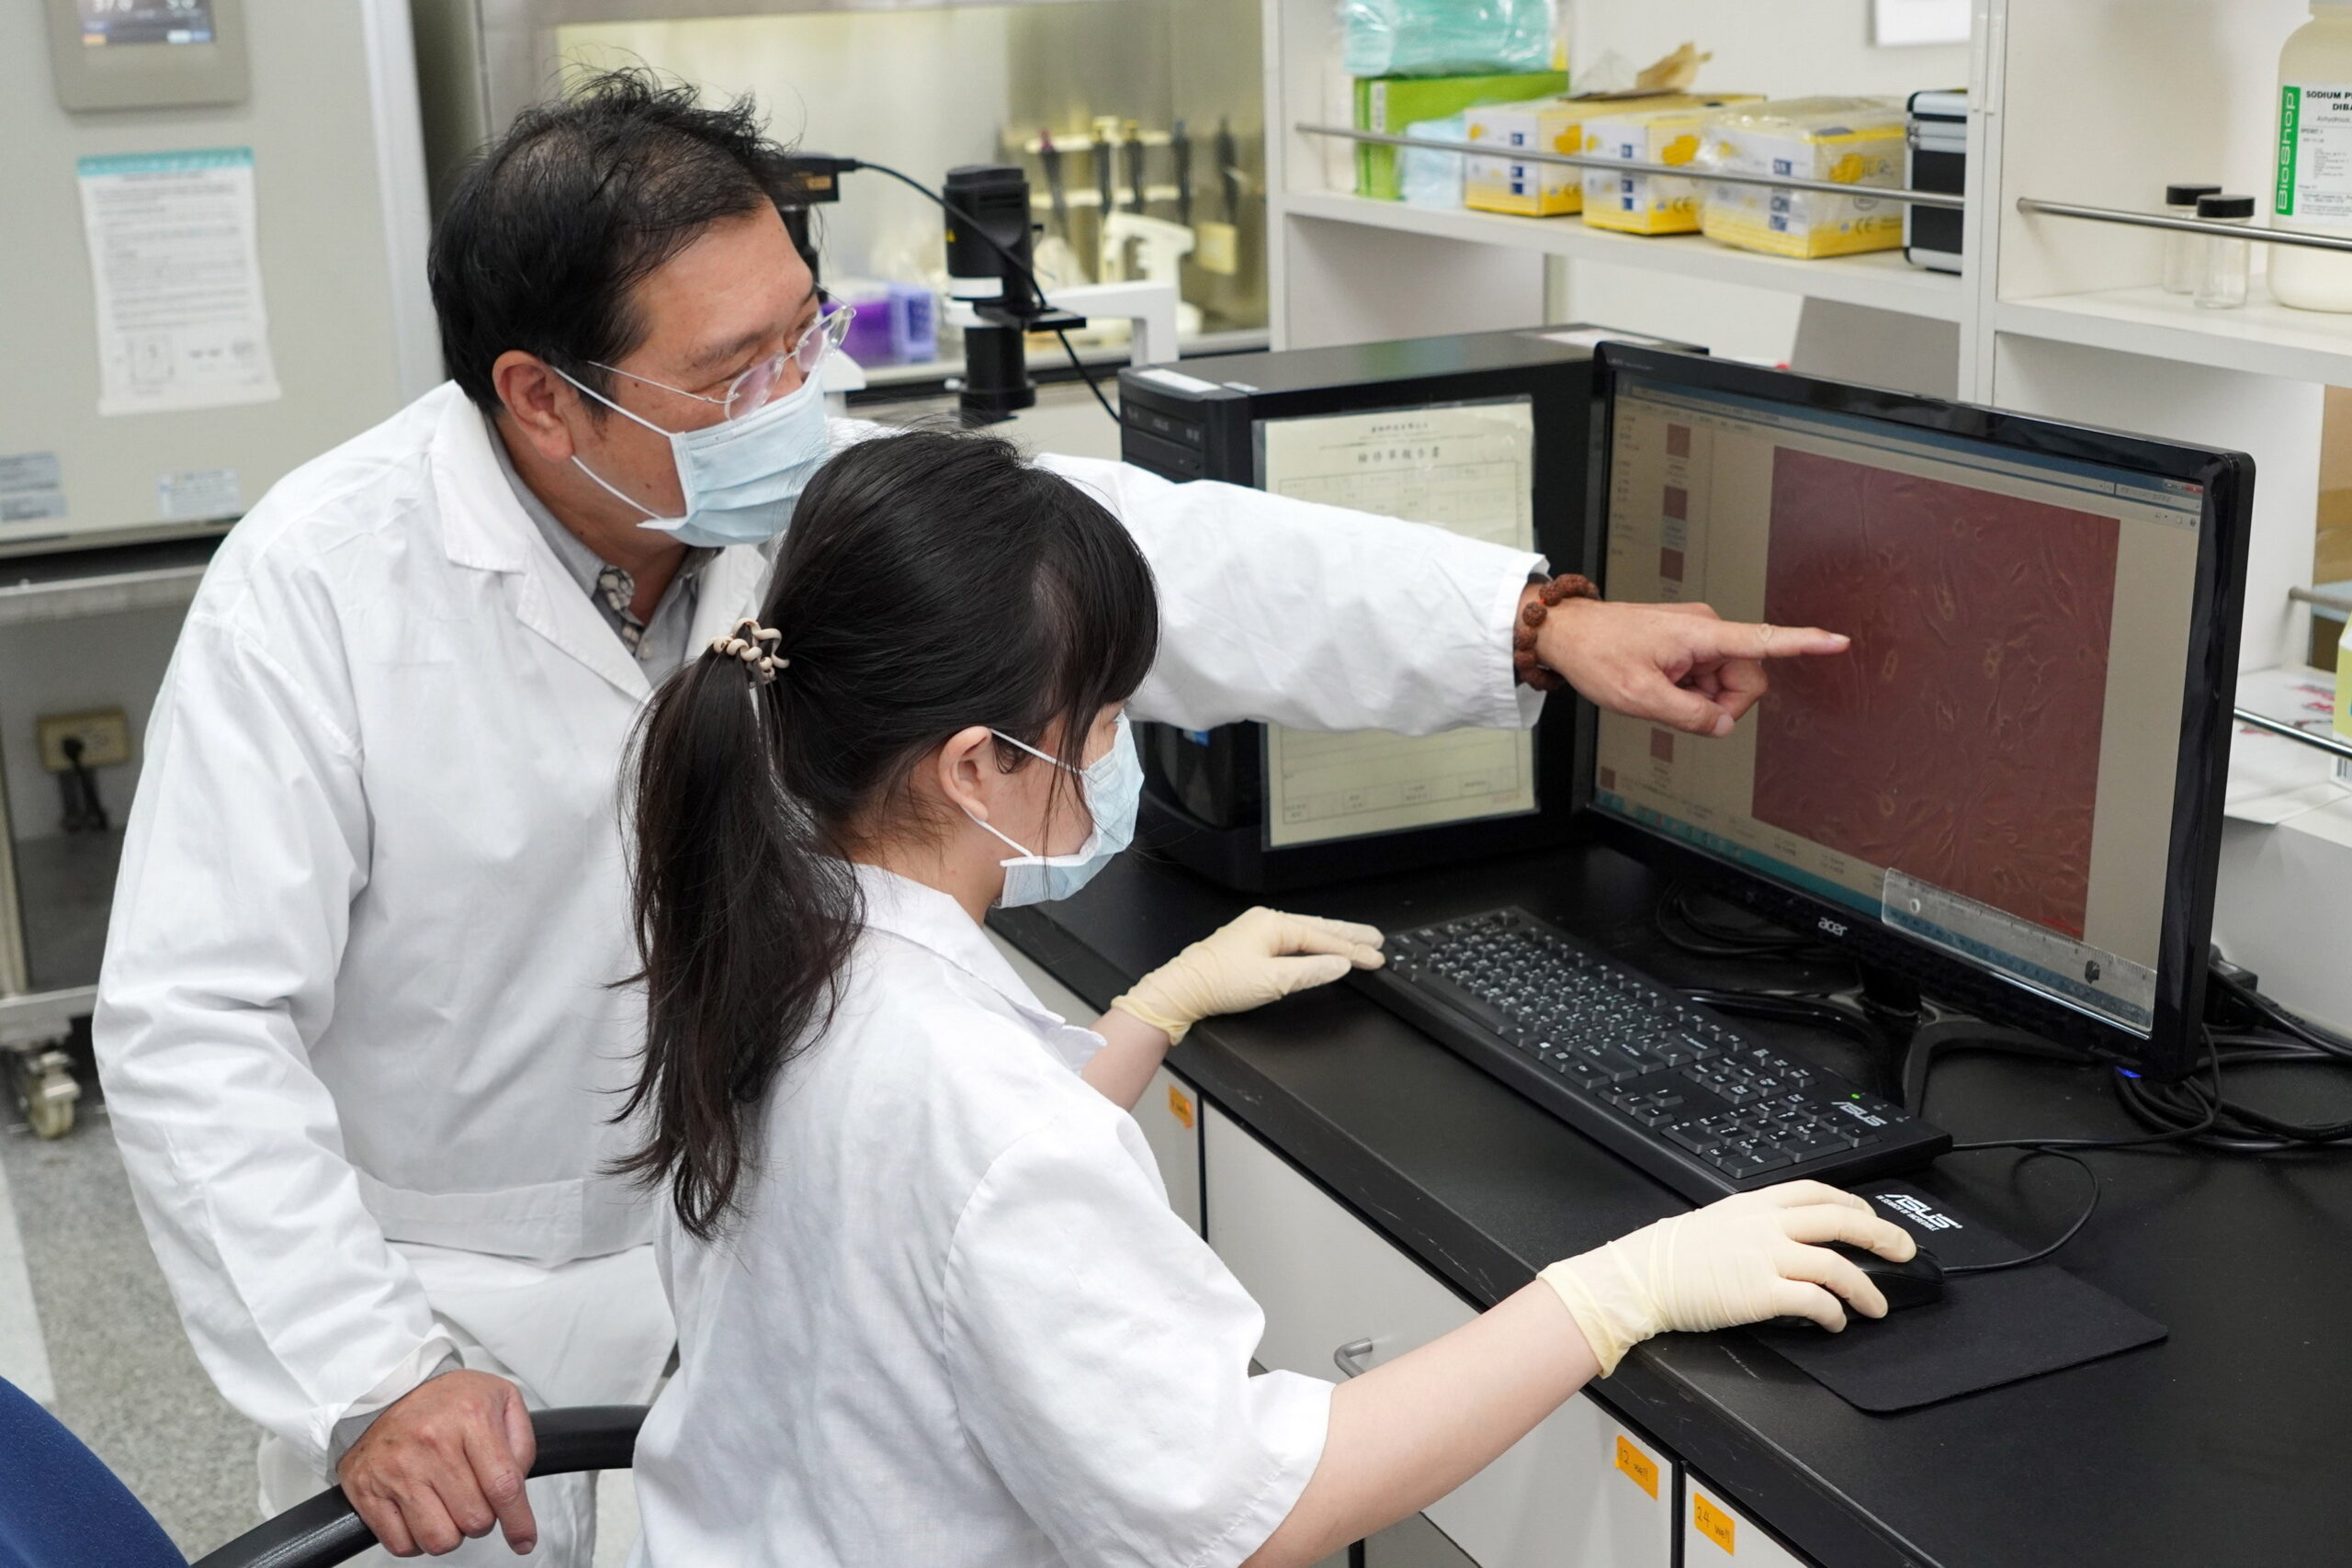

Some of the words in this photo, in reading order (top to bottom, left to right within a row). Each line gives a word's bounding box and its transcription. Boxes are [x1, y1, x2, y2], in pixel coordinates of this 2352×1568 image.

[2306, 90, 2342, 100] SODIUM
[1817, 917, 1849, 937] acer
[1830, 1101, 1889, 1127] ASUS
[1883, 1193, 1960, 1229] ASUS
[1697, 1506, 1711, 1525] 24
